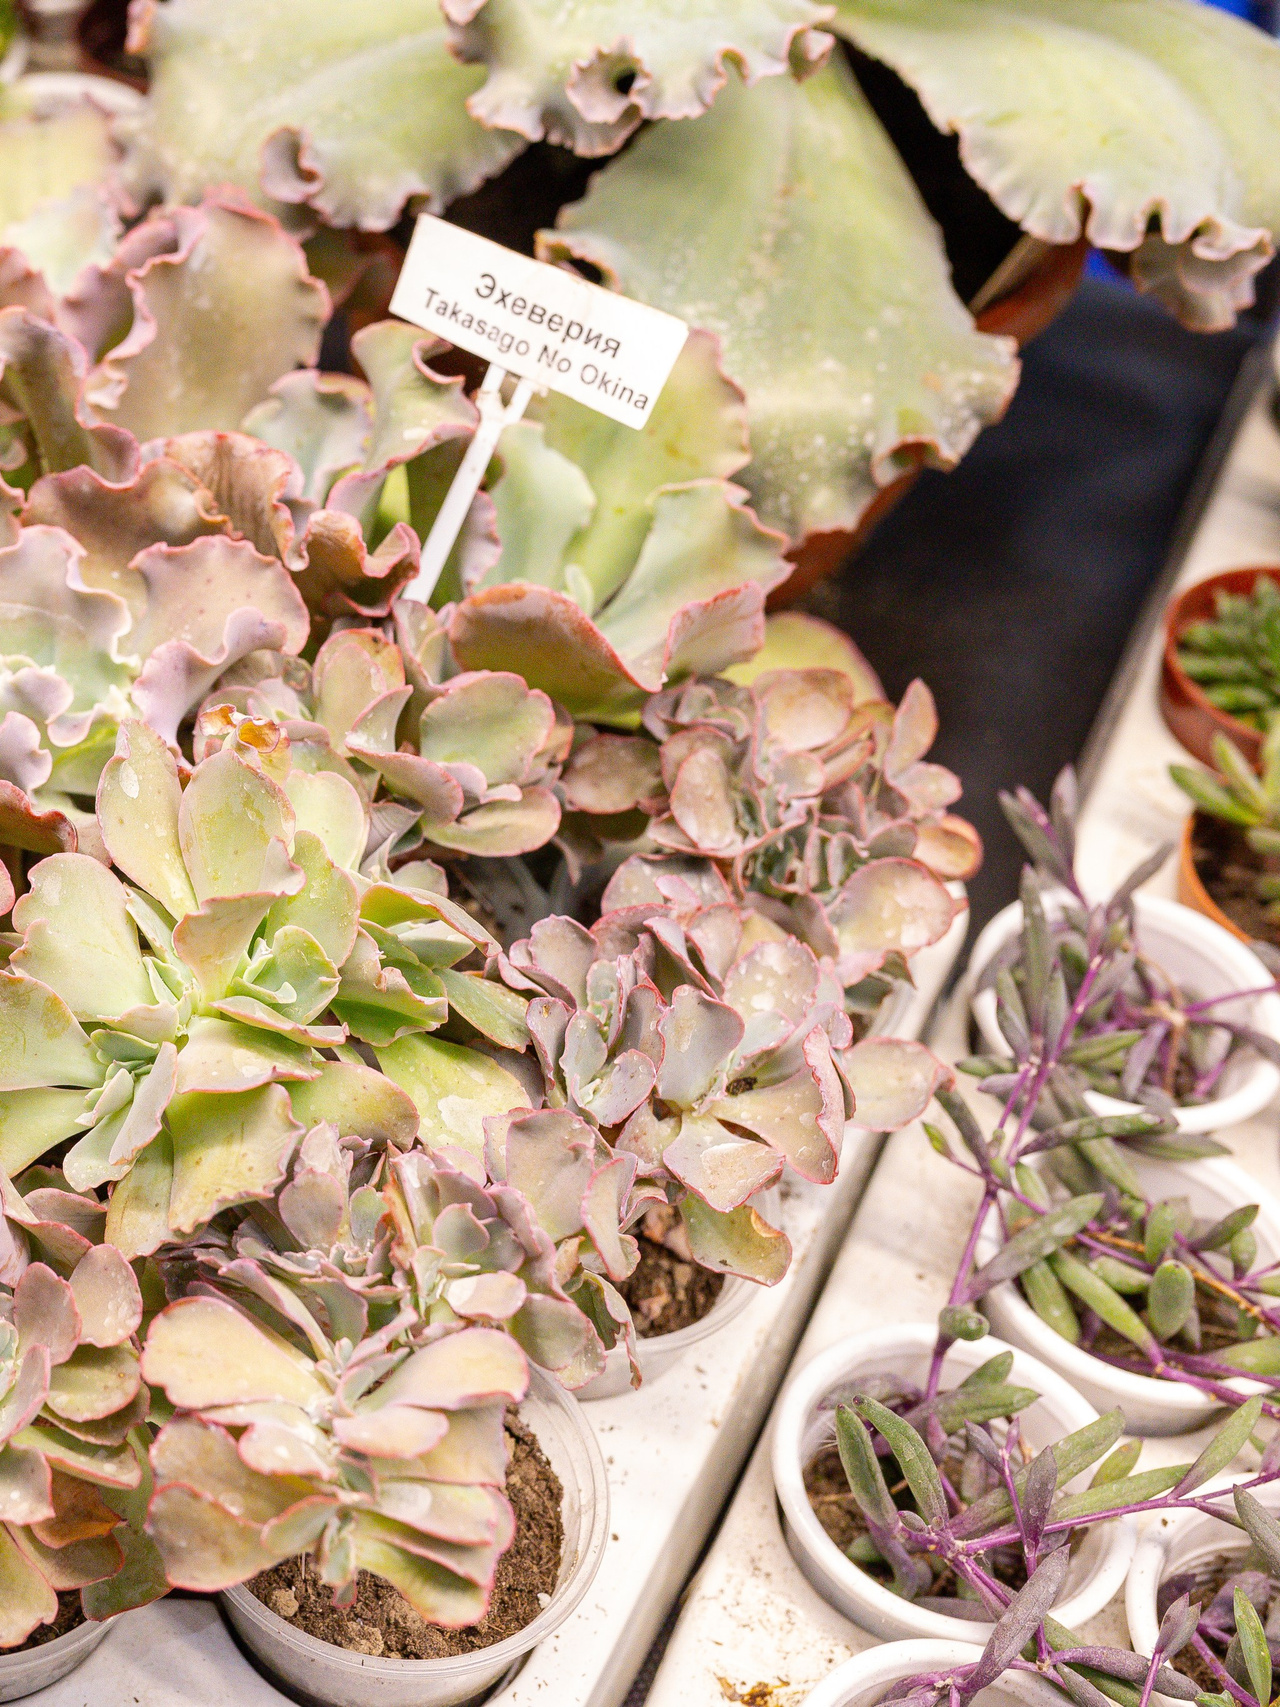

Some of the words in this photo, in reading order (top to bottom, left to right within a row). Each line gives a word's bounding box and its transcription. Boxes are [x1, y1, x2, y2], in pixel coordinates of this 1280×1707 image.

[423, 287, 531, 356] Takasago
[537, 344, 572, 373] No
[579, 363, 649, 411] Okina
[475, 273, 621, 358] Эхеверия
